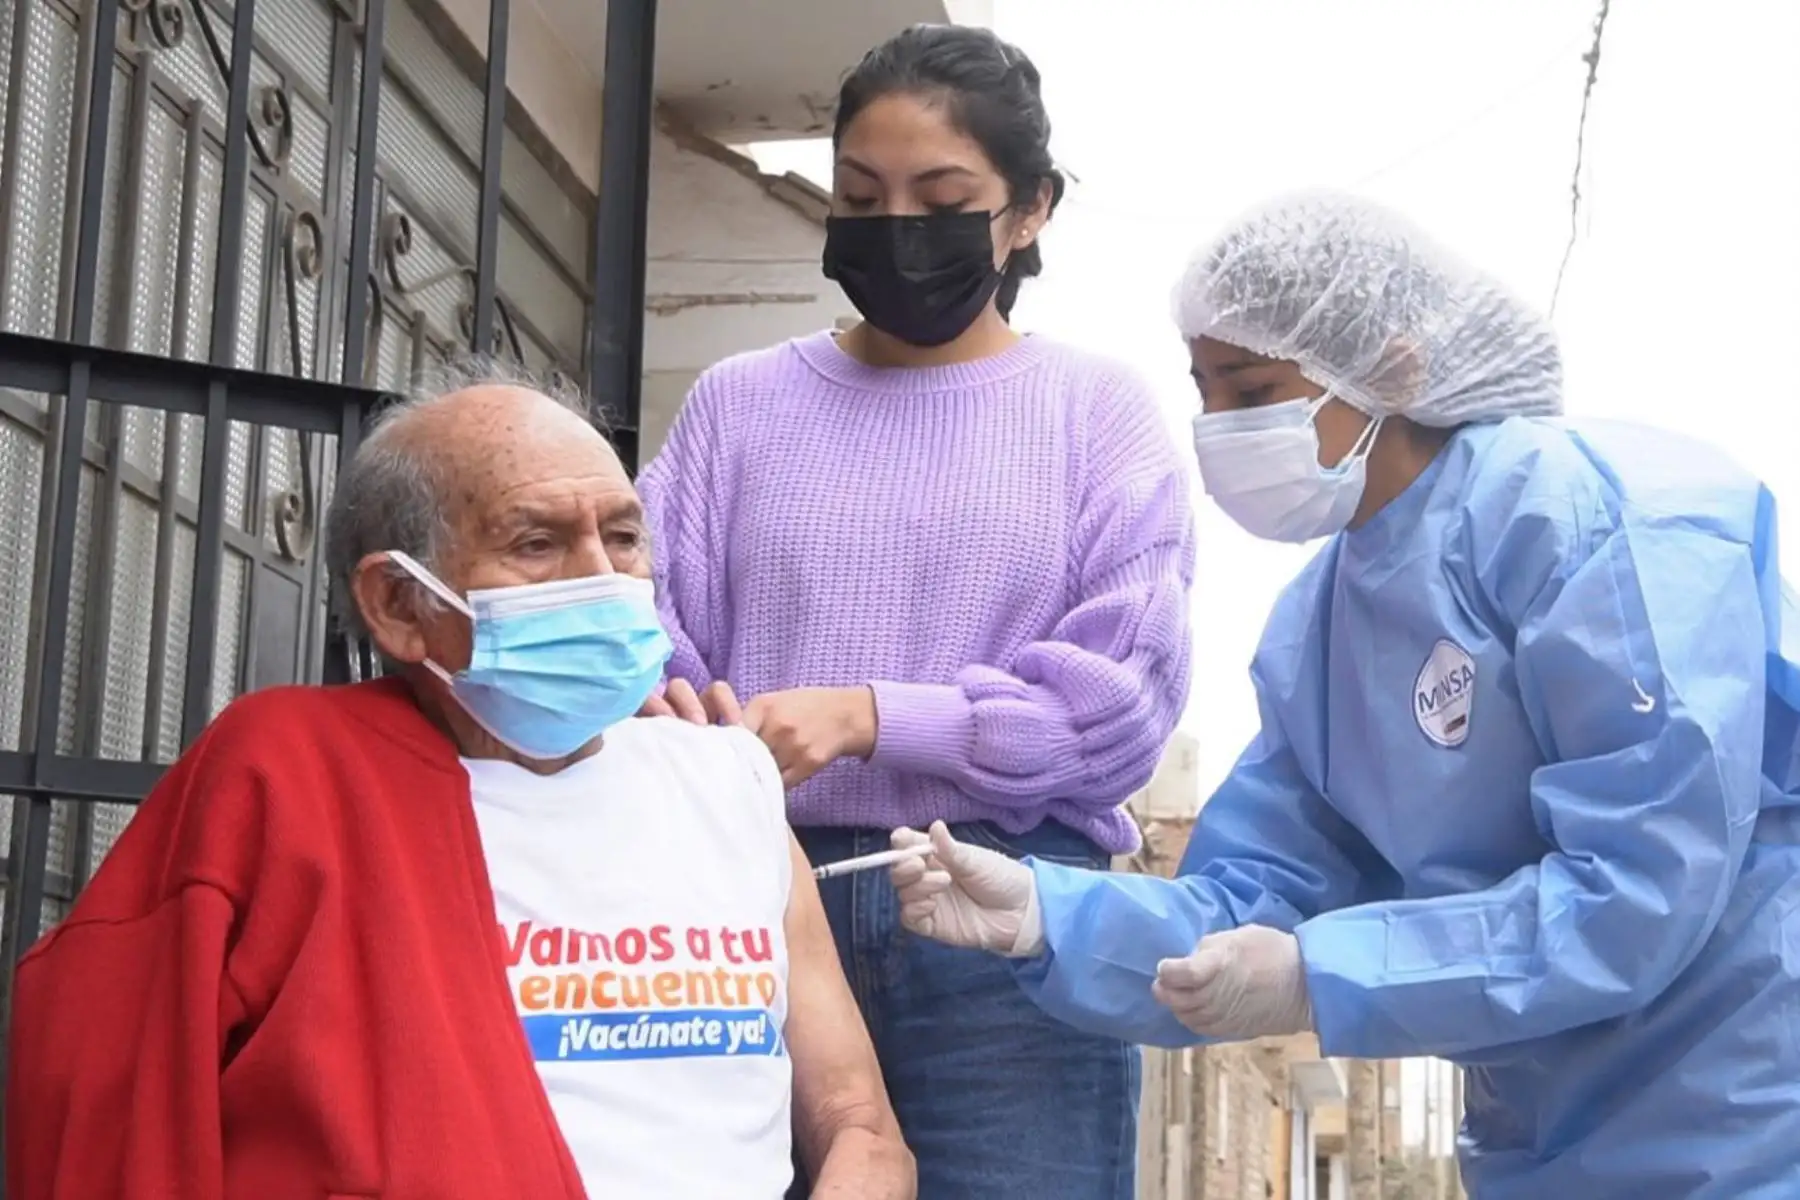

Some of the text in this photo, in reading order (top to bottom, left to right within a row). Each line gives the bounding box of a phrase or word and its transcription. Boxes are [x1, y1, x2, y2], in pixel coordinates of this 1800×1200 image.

[497, 920, 774, 966] Vamos a tu
[518, 966, 778, 1010] encuentro
[558, 1013, 767, 1058] ¡Vacúnate ya!
